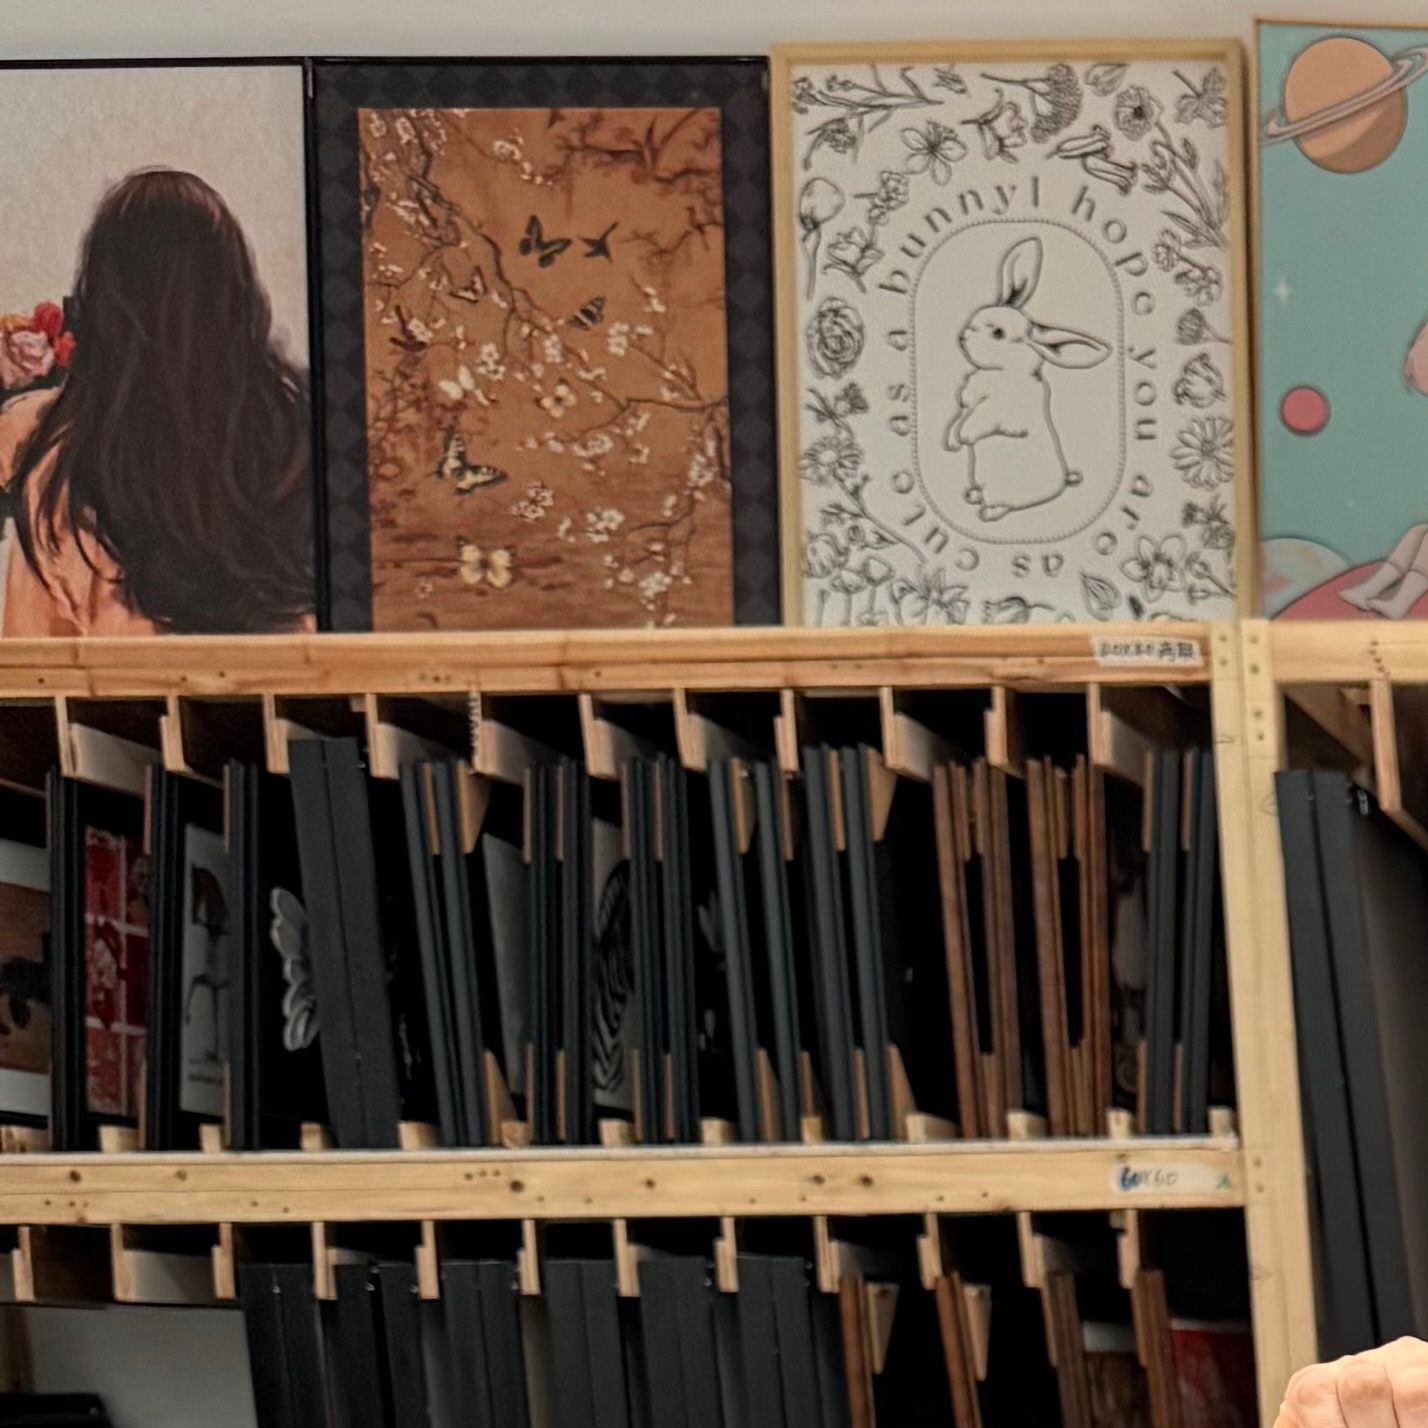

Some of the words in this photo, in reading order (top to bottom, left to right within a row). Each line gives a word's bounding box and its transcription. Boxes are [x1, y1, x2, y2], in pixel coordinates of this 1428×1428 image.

[878, 183, 1017, 297] bunny
[1072, 186, 1156, 316] hope
[890, 328, 911, 353] a
[887, 382, 913, 438] as
[1128, 345, 1160, 442] you
[891, 470, 980, 573] cute
[1094, 474, 1154, 557] are
[1012, 554, 1064, 579] as
